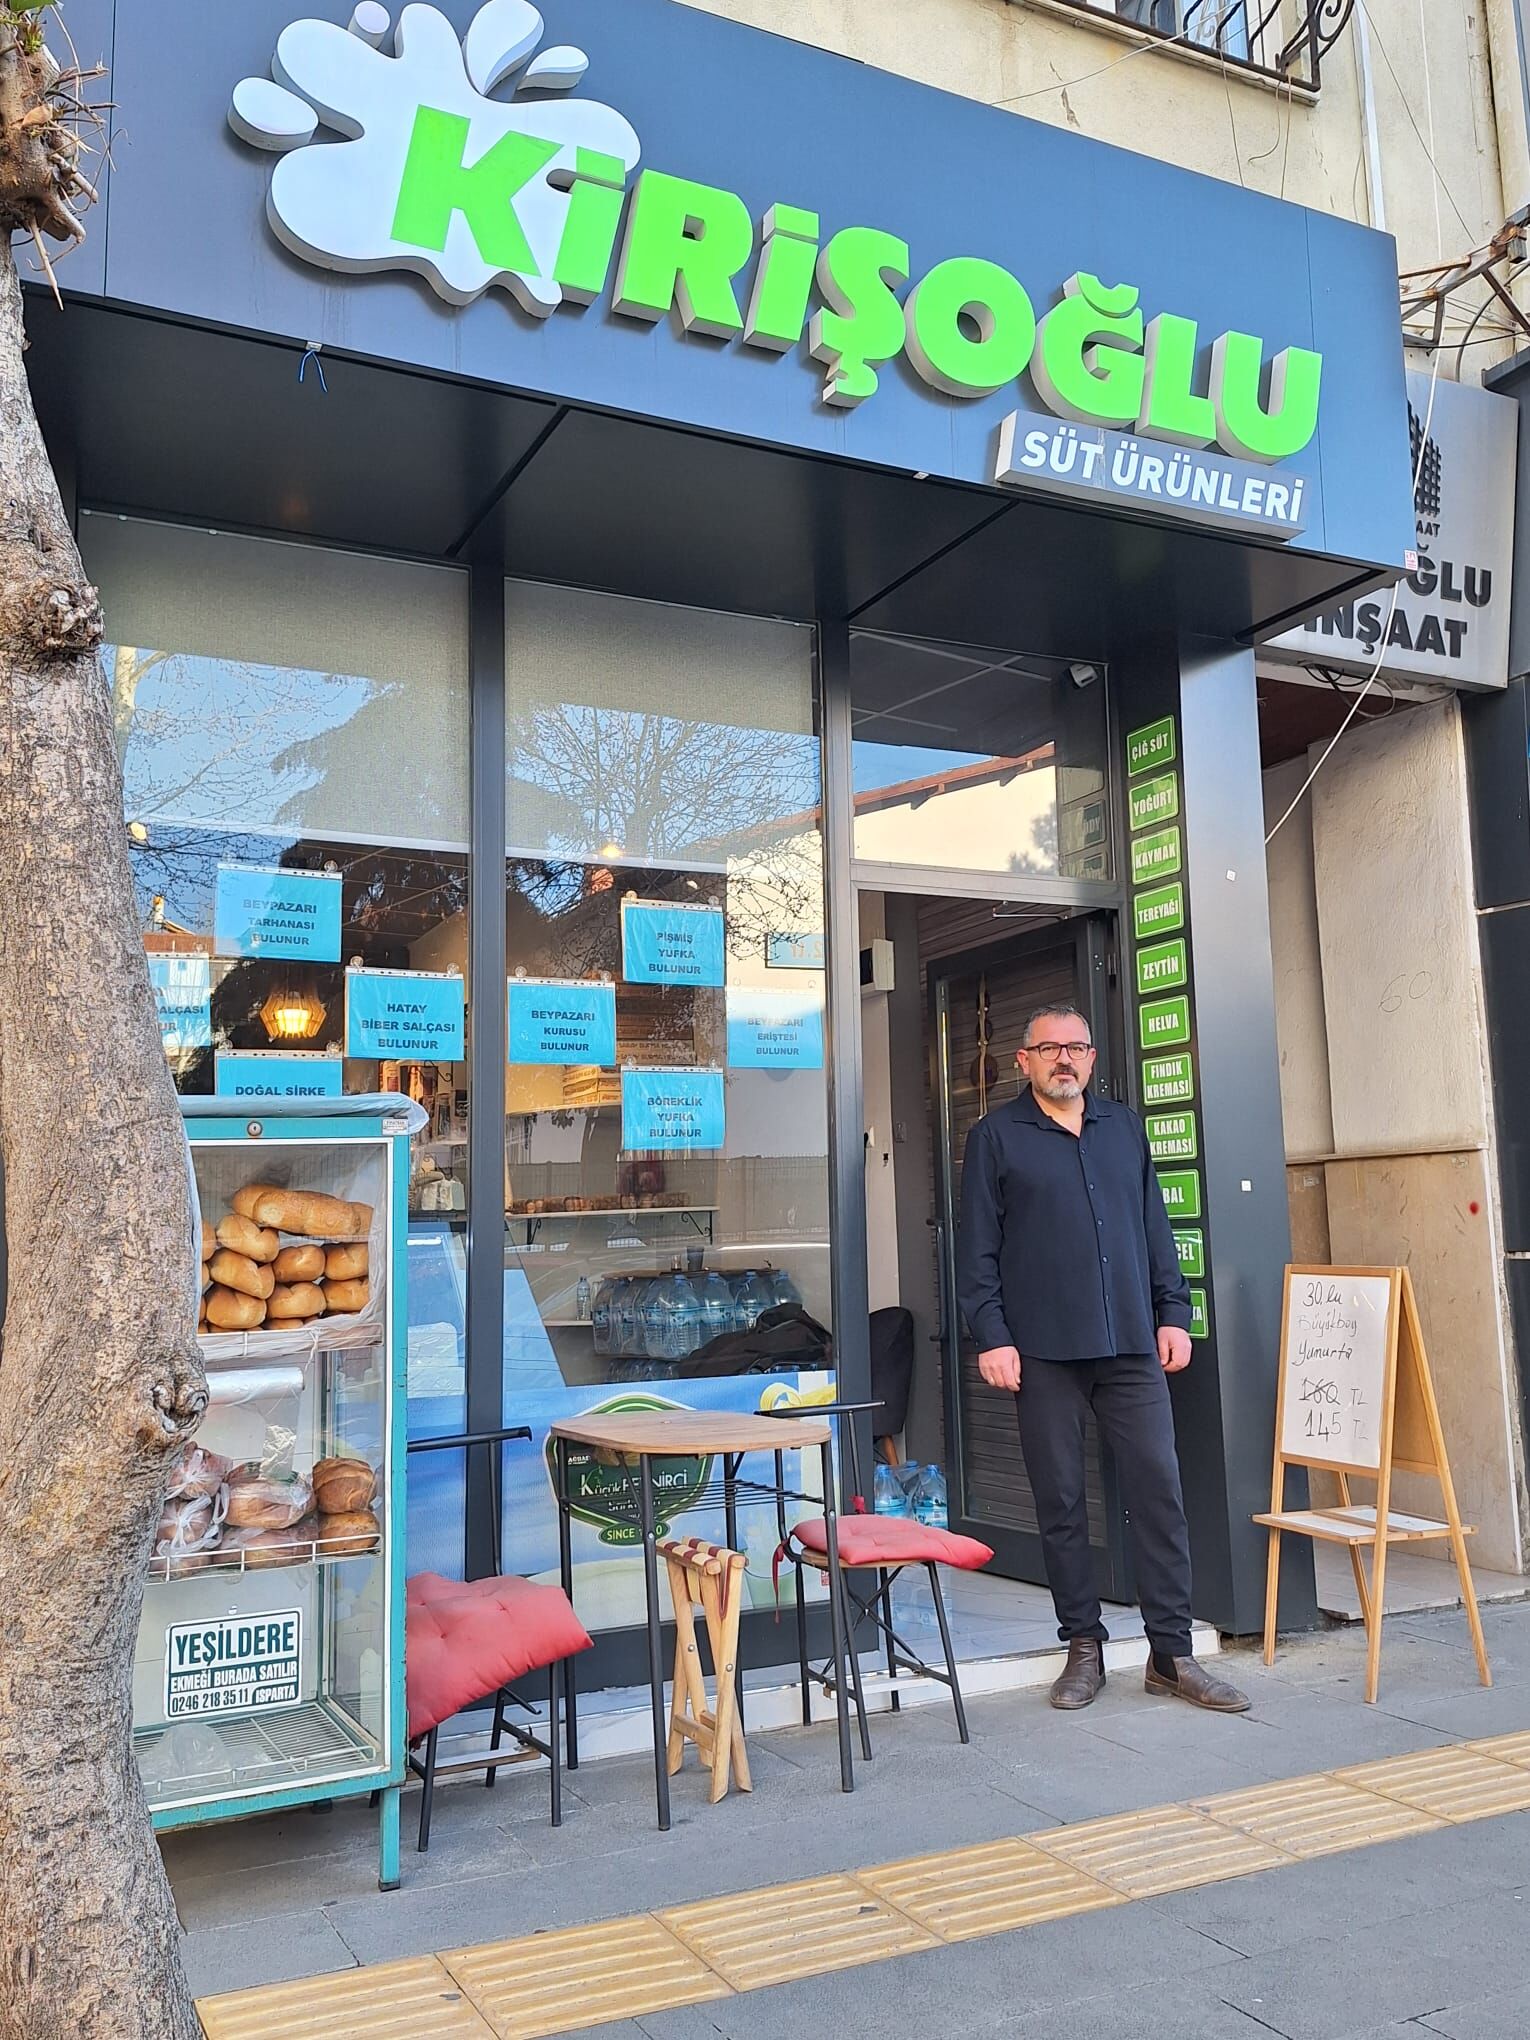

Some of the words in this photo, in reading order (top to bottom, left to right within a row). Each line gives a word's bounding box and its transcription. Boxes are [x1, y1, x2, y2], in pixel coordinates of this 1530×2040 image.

[390, 104, 1323, 464] KİRİŞOĞLU
[1020, 427, 1103, 481] SÜT
[1110, 440, 1304, 523] ÜRÜNLERİ
[1132, 740, 1148, 763] ÇİĞ
[1150, 732, 1168, 753] SÜT
[1133, 789, 1172, 817] YOĞURT
[1135, 843, 1176, 870] KAYMAK
[243, 899, 317, 914] BEYPAZARI
[1138, 899, 1179, 924] TEREYAĞI
[250, 917, 315, 930] TARHANASI
[253, 933, 309, 945] BULUNUR
[656, 932, 693, 945] PİŞMİŞ
[657, 948, 695, 959] YUFKA
[649, 963, 701, 974] BULUNUR
[1143, 955, 1179, 981] ZEYTİN
[158, 1006, 204, 1016] ALÇASI
[387, 1003, 427, 1013] HATAY
[531, 1010, 595, 1021] BEYPAZARI
[361, 1020, 399, 1031] BİBER
[402, 1021, 456, 1034] SALÇASI
[748, 1017, 804, 1027] BEYPAZARI
[1148, 1013, 1179, 1032] HELVA
[543, 1027, 587, 1037] KURUSU
[757, 1031, 798, 1042] ERİŞTESİ
[378, 1038, 438, 1050] BULUNUR
[540, 1042, 589, 1051] BULUNUR
[755, 1046, 800, 1056] BULUNUR
[1151, 1061, 1183, 1079] FINDIK
[235, 1084, 281, 1096] DOĞAL
[285, 1084, 326, 1096] SİRKE
[1147, 1077, 1189, 1098] KREMASI
[647, 1095, 702, 1107] BÖREKLİK
[657, 1112, 695, 1122] YUFKA
[649, 1128, 702, 1138] BULUNUR
[1153, 1118, 1186, 1135] KAKAO
[1150, 1136, 1192, 1155] KREMASI
[1162, 1186, 1185, 1203] BAL
[1292, 1340, 1353, 1366] Yumurta
[1350, 1388, 1369, 1405] TL
[1305, 1409, 1342, 1443] 145
[1353, 1419, 1369, 1440] TL
[607, 1528, 635, 1541] SINCE
[176, 1621, 295, 1666] YEŞİLDERE
[171, 1669, 211, 1693] EKMEĞİ
[214, 1667, 257, 1687] BURADA
[259, 1661, 298, 1680] SATILIR
[256, 1684, 295, 1703] ISPARTA
[172, 1695, 199, 1713] 0246
[203, 1692, 221, 1708] 218
